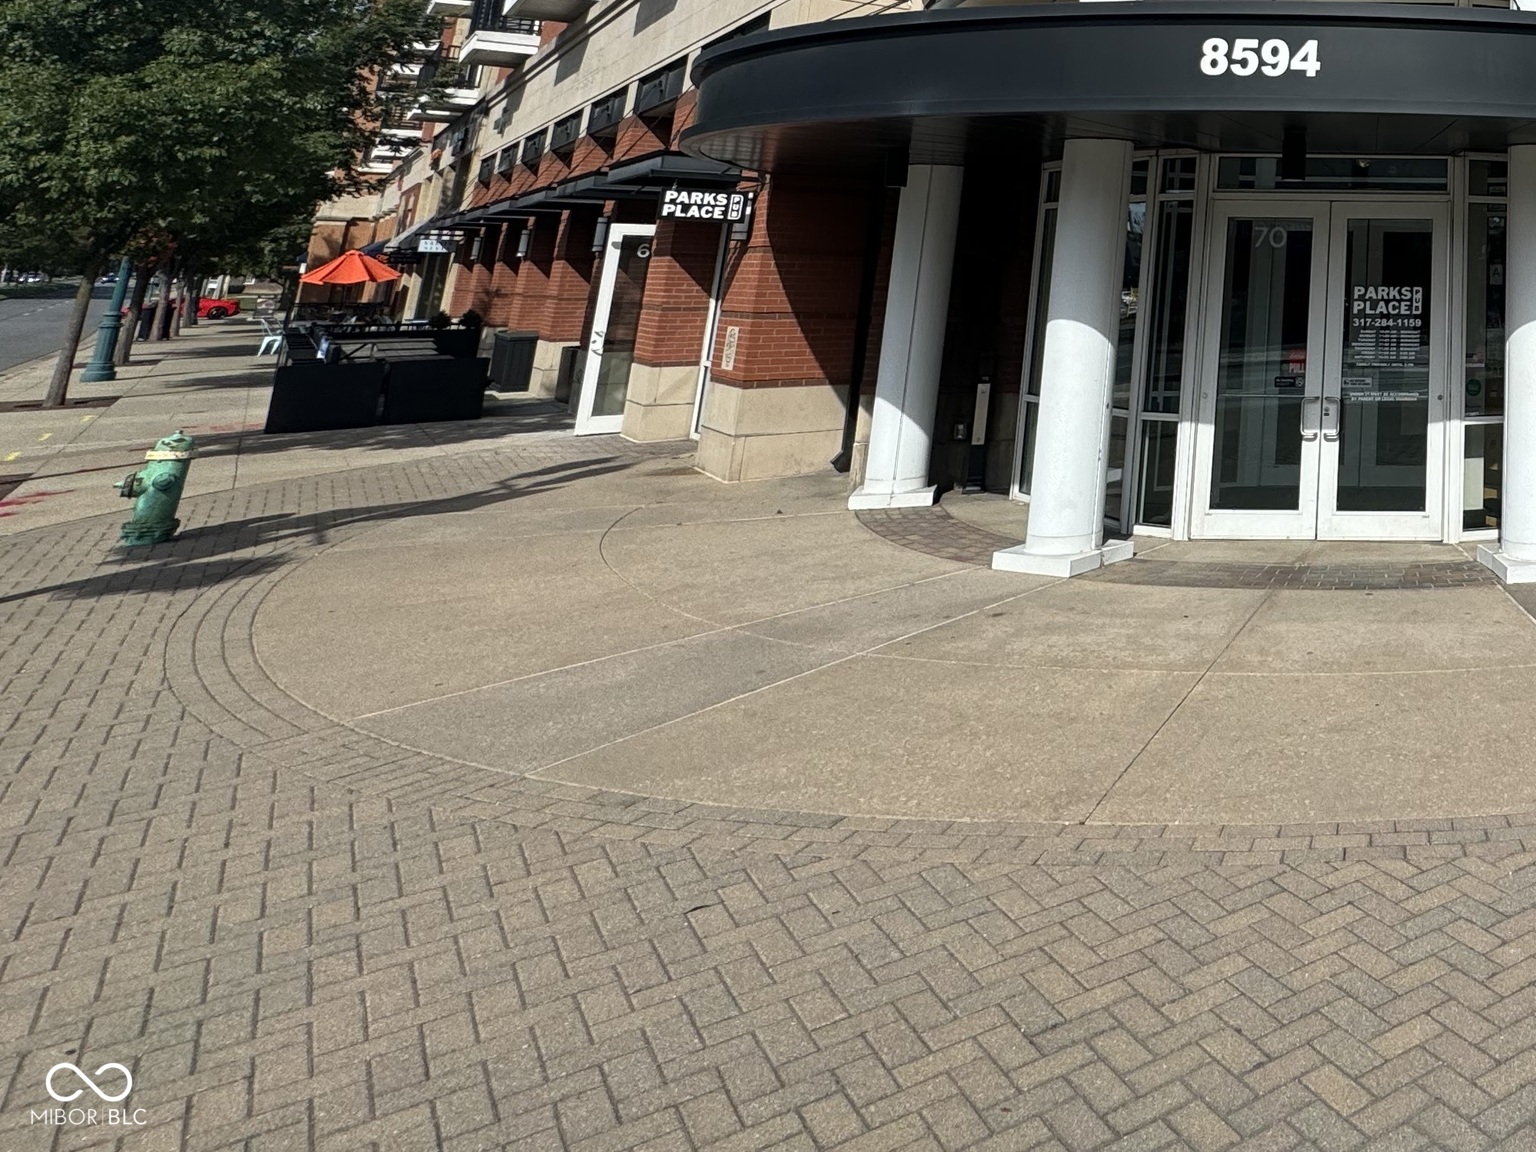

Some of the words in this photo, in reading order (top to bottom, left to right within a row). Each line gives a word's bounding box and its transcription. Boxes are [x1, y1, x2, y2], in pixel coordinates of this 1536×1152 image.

[1200, 37, 1321, 77] 8594
[664, 190, 728, 206] PARKS
[661, 204, 726, 219] PLACE
[1254, 226, 1288, 248] 70
[1353, 286, 1412, 300] PARKS
[1352, 301, 1411, 315] PLACE
[1352, 318, 1422, 327] 317-284-1159
